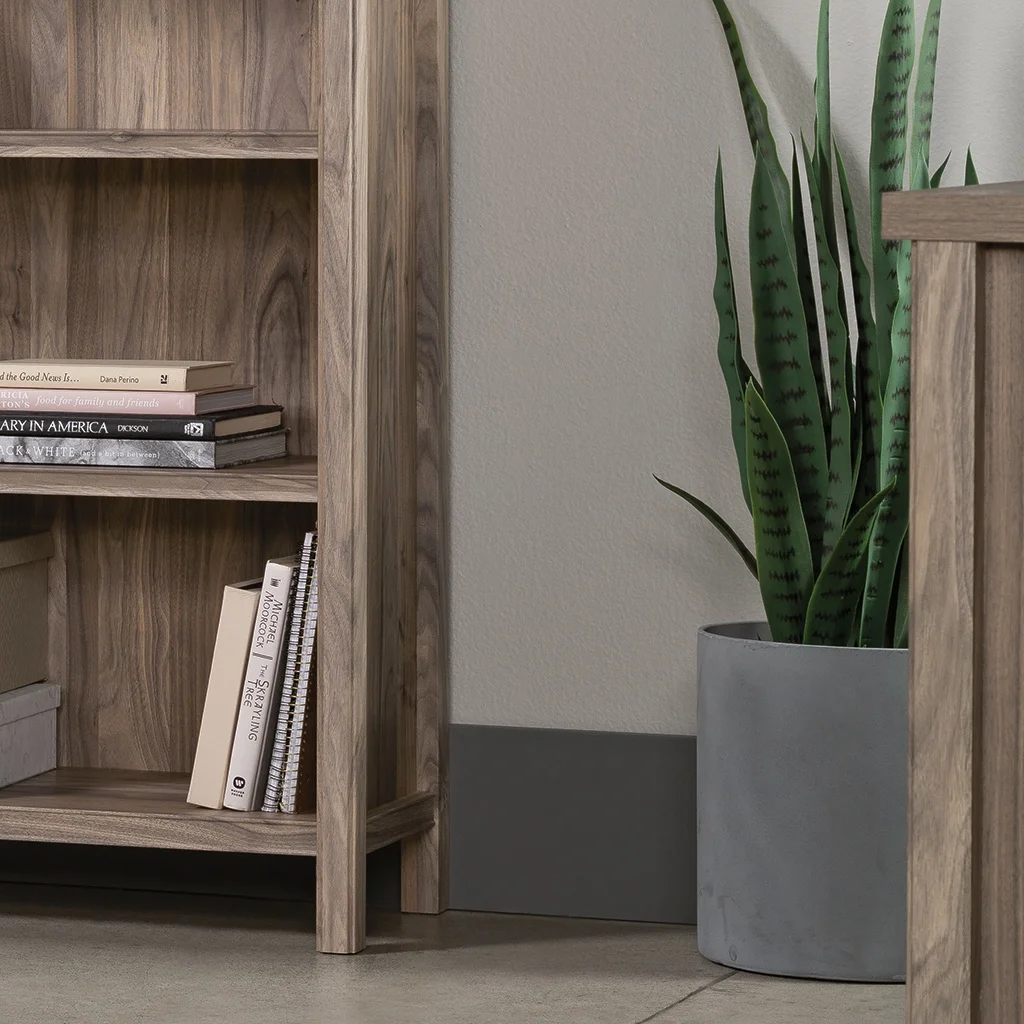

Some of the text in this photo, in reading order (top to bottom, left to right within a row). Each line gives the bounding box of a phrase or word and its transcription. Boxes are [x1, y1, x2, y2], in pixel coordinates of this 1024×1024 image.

[6, 371, 18, 381] the
[19, 371, 40, 382] Good
[41, 372, 62, 382] News
[99, 375, 140, 384] Dana Perino
[35, 395, 160, 408] food for family and friends
[29, 419, 45, 432] IN
[47, 420, 109, 434] AMERICA
[117, 425, 149, 433] DICKSON
[32, 445, 75, 457] WHITE
[256, 590, 274, 649] MOORCOCK
[266, 599, 283, 644] MICHAEL
[243, 679, 258, 708] TREE
[248, 679, 270, 742] SKRAYLING
